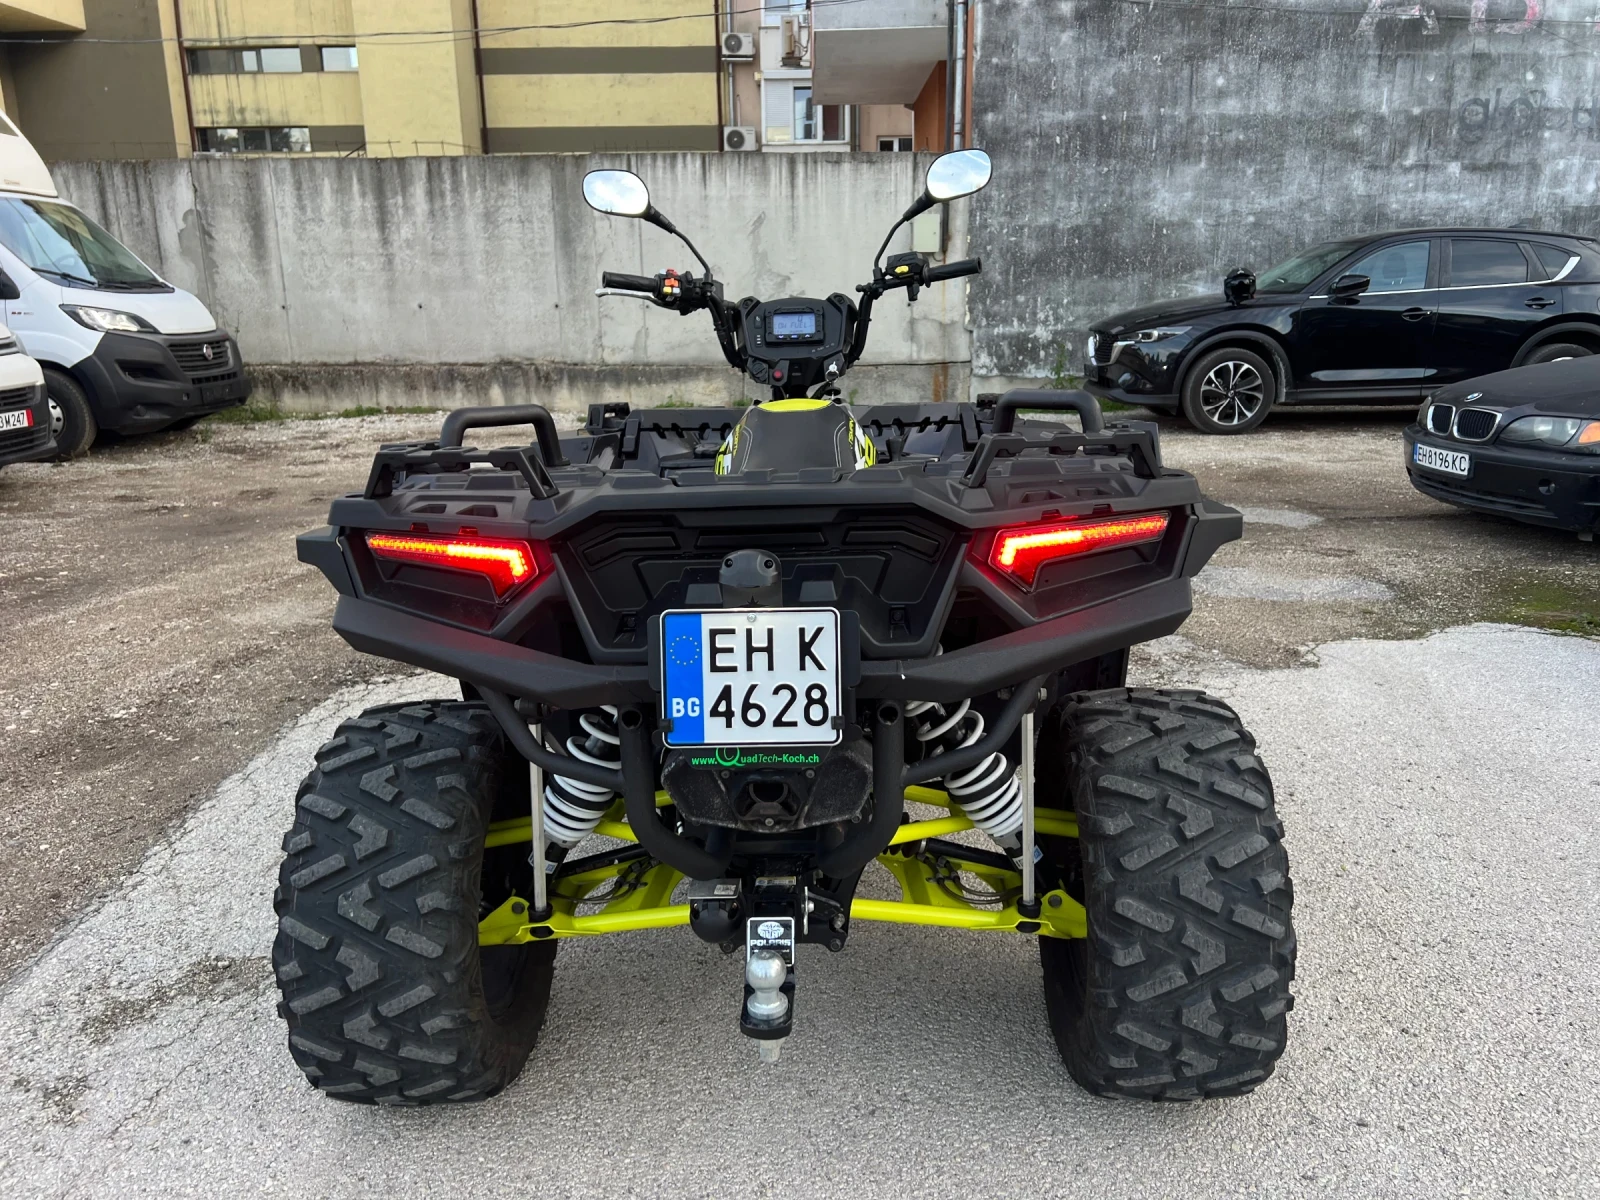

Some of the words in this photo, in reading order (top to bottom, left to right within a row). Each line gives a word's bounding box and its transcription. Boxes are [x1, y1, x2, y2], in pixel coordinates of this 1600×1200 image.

[708, 627, 775, 673] EH
[798, 626, 827, 671] K
[671, 697, 700, 717] BG
[709, 682, 829, 729] 4628
[691, 747, 820, 767] www.QuadTech-Koch.ch
[750, 939, 791, 947] POLARIS
